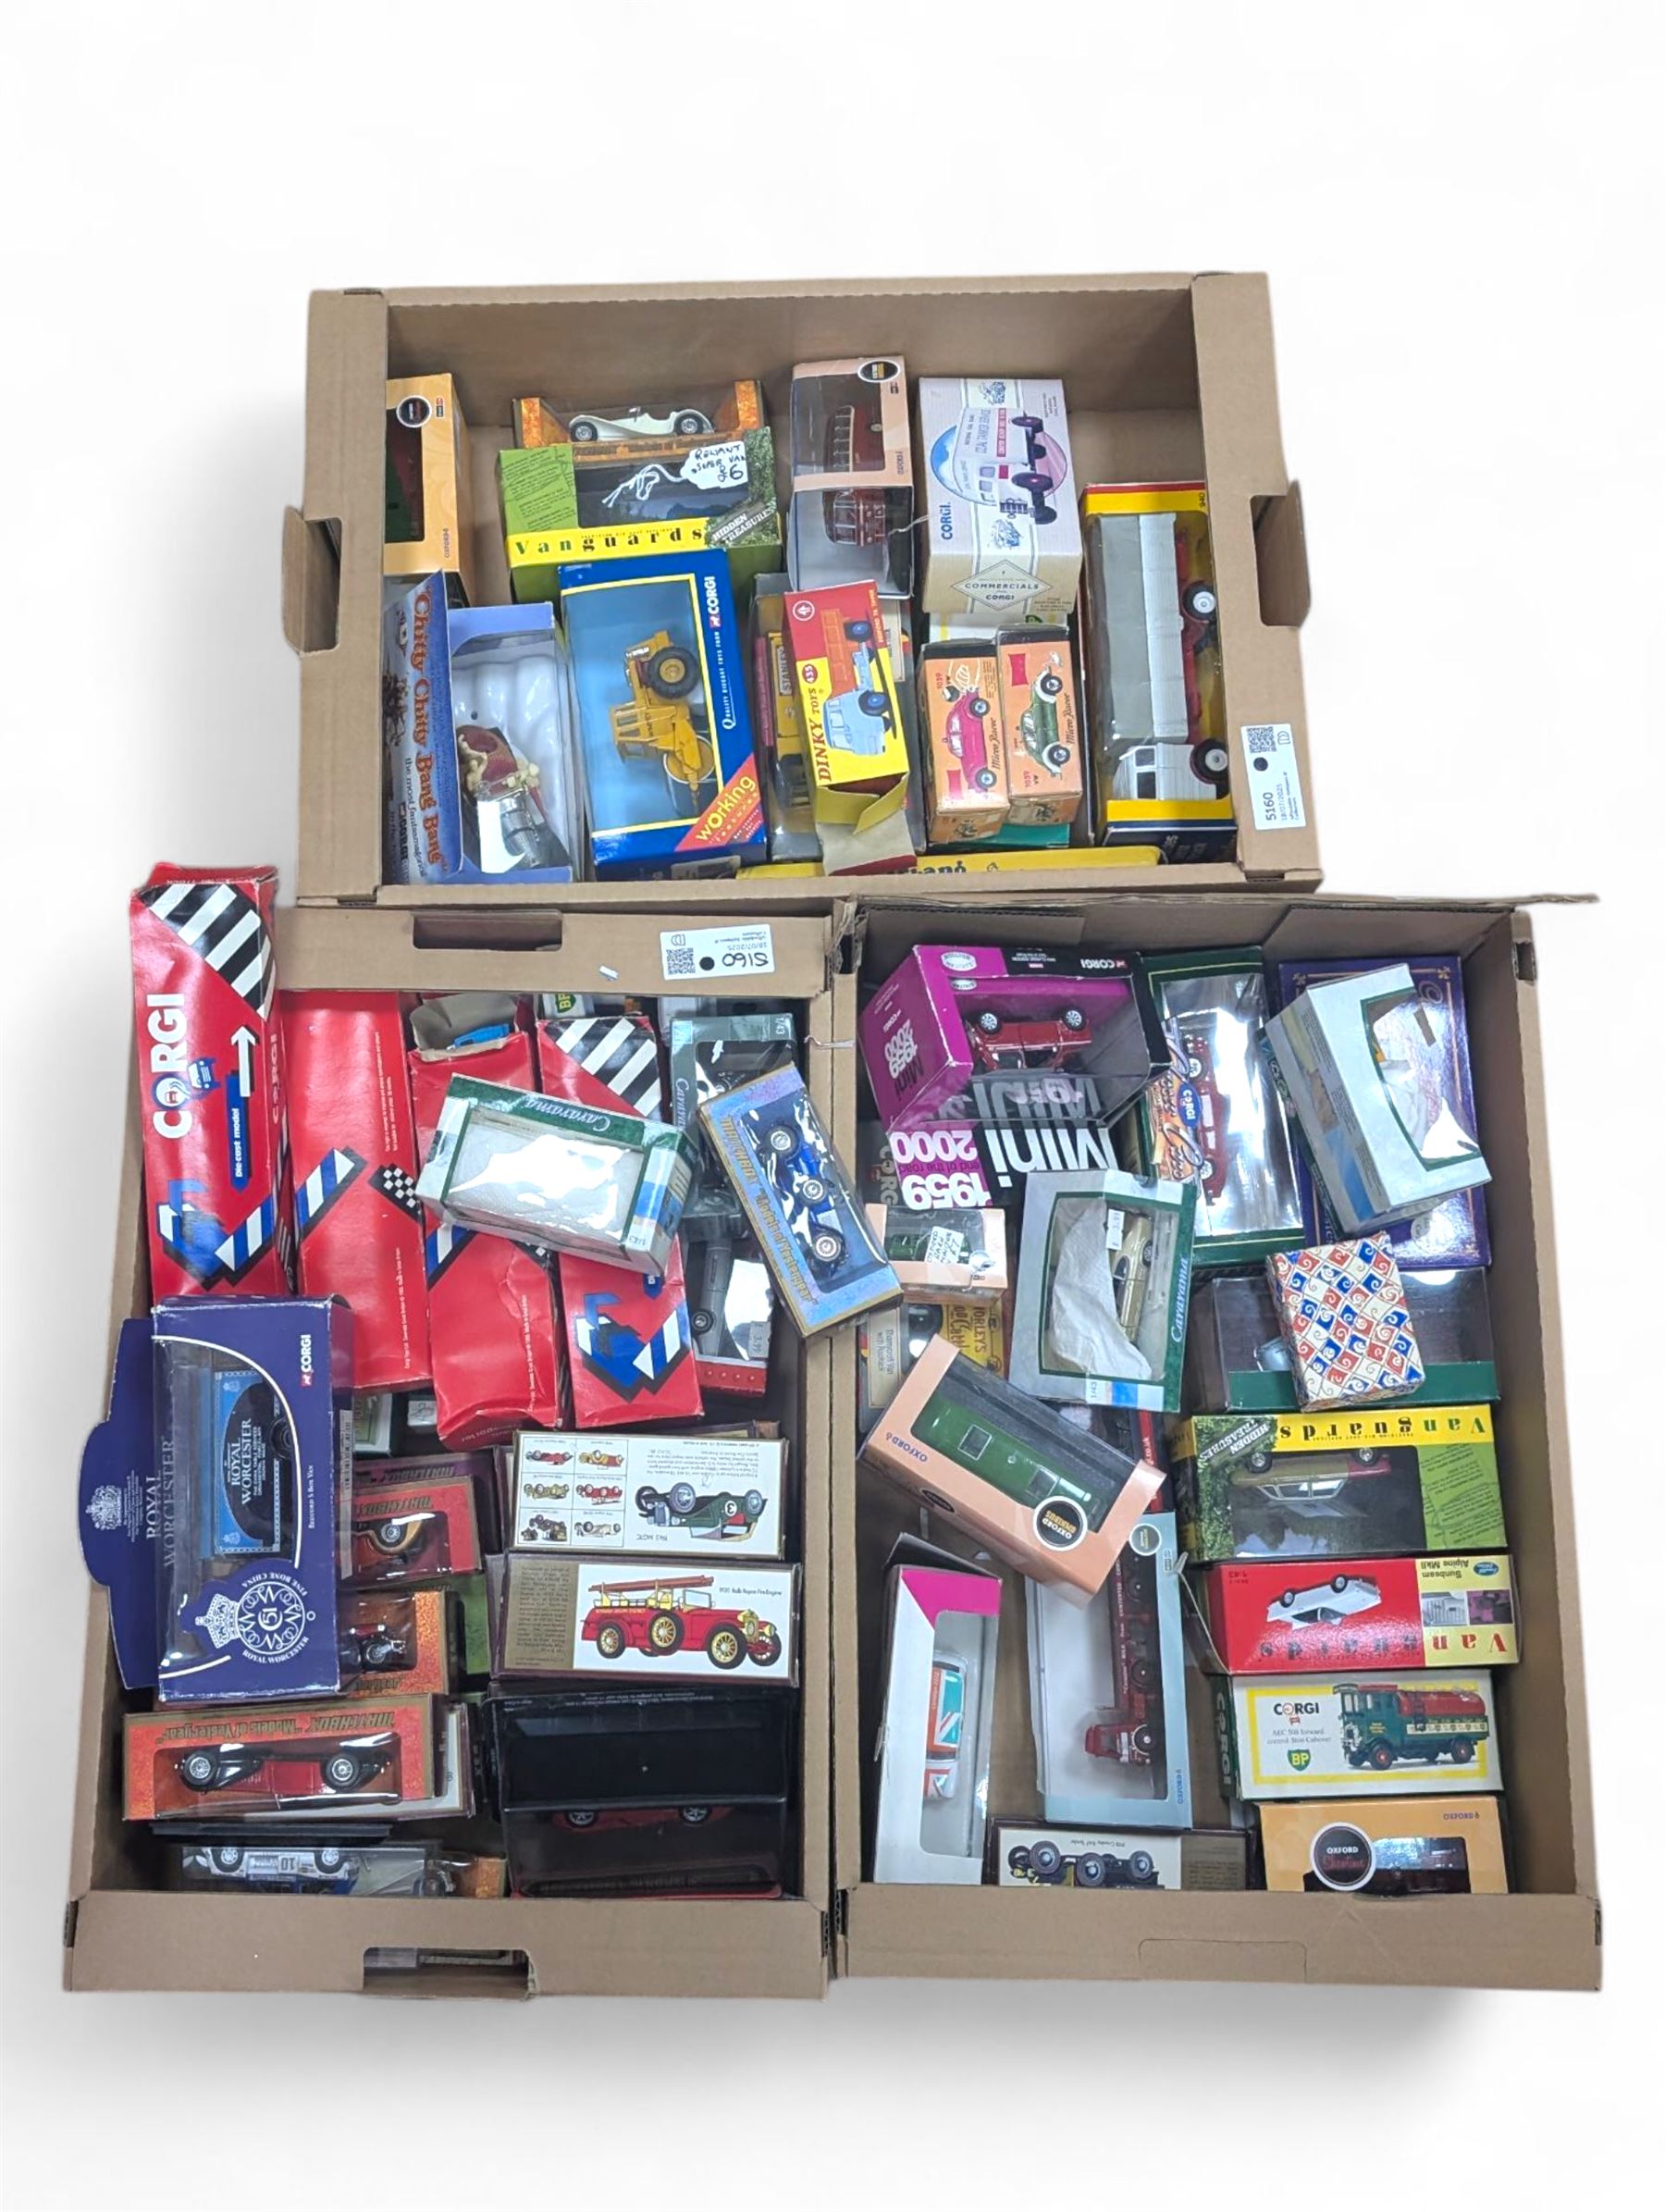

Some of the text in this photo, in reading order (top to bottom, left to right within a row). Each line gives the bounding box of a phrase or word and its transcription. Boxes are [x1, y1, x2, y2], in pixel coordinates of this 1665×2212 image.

[710, 513, 747, 542] HIDDEN
[724, 506, 775, 544] TREASURES
[940, 501, 952, 540] CORGI
[705, 575, 719, 614] CORGI
[965, 582, 1039, 590] COMMERCIALS
[875, 618, 883, 643] BEDFORD
[413, 678, 432, 745] Chitty
[809, 688, 832, 781] DINKY TOYS
[415, 751, 438, 811] Bang
[696, 775, 756, 842] working
[1263, 791, 1276, 821] 5160
[1080, 958, 1115, 969] CORGI
[557, 993, 572, 1011] BP
[774, 1018, 784, 1034] 1/43
[146, 993, 193, 1140] CORGI
[1181, 1088, 1196, 1121] CORGI
[233, 1107, 241, 1139] model
[891, 1131, 979, 1164] 2000
[880, 1145, 899, 1205] CORG
[898, 1161, 980, 1173] end of the road
[901, 1171, 993, 1210] 1959
[300, 1334, 312, 1373] CORGI
[890, 1432, 929, 1464] OXFORD
[1199, 1417, 1259, 1463] TREASURES
[1230, 1423, 1270, 1455] HIDDEN
[230, 1437, 241, 1486] ROYAL
[240, 1418, 253, 1506] WORCESTER
[145, 1471, 163, 1540] ROYAL
[162, 1440, 176, 1567] WORCESTER
[726, 1501, 735, 1515] 3
[1042, 1517, 1072, 1539] OXFORD
[1421, 1569, 1462, 1579] Sunbeam
[1442, 1558, 1470, 1570] Alpine
[240, 1571, 308, 1597] FINE BONE CHINA
[241, 1635, 310, 1663] ROYAL WORCESTER
[1273, 1701, 1320, 1716] CORGI
[1216, 1692, 1233, 1786] CORGI
[1290, 1751, 1311, 1766] BP
[1443, 1812, 1475, 1821] OXFORD
[280, 1858, 296, 1871] 10
[1326, 1846, 1359, 1854] OXFORD
